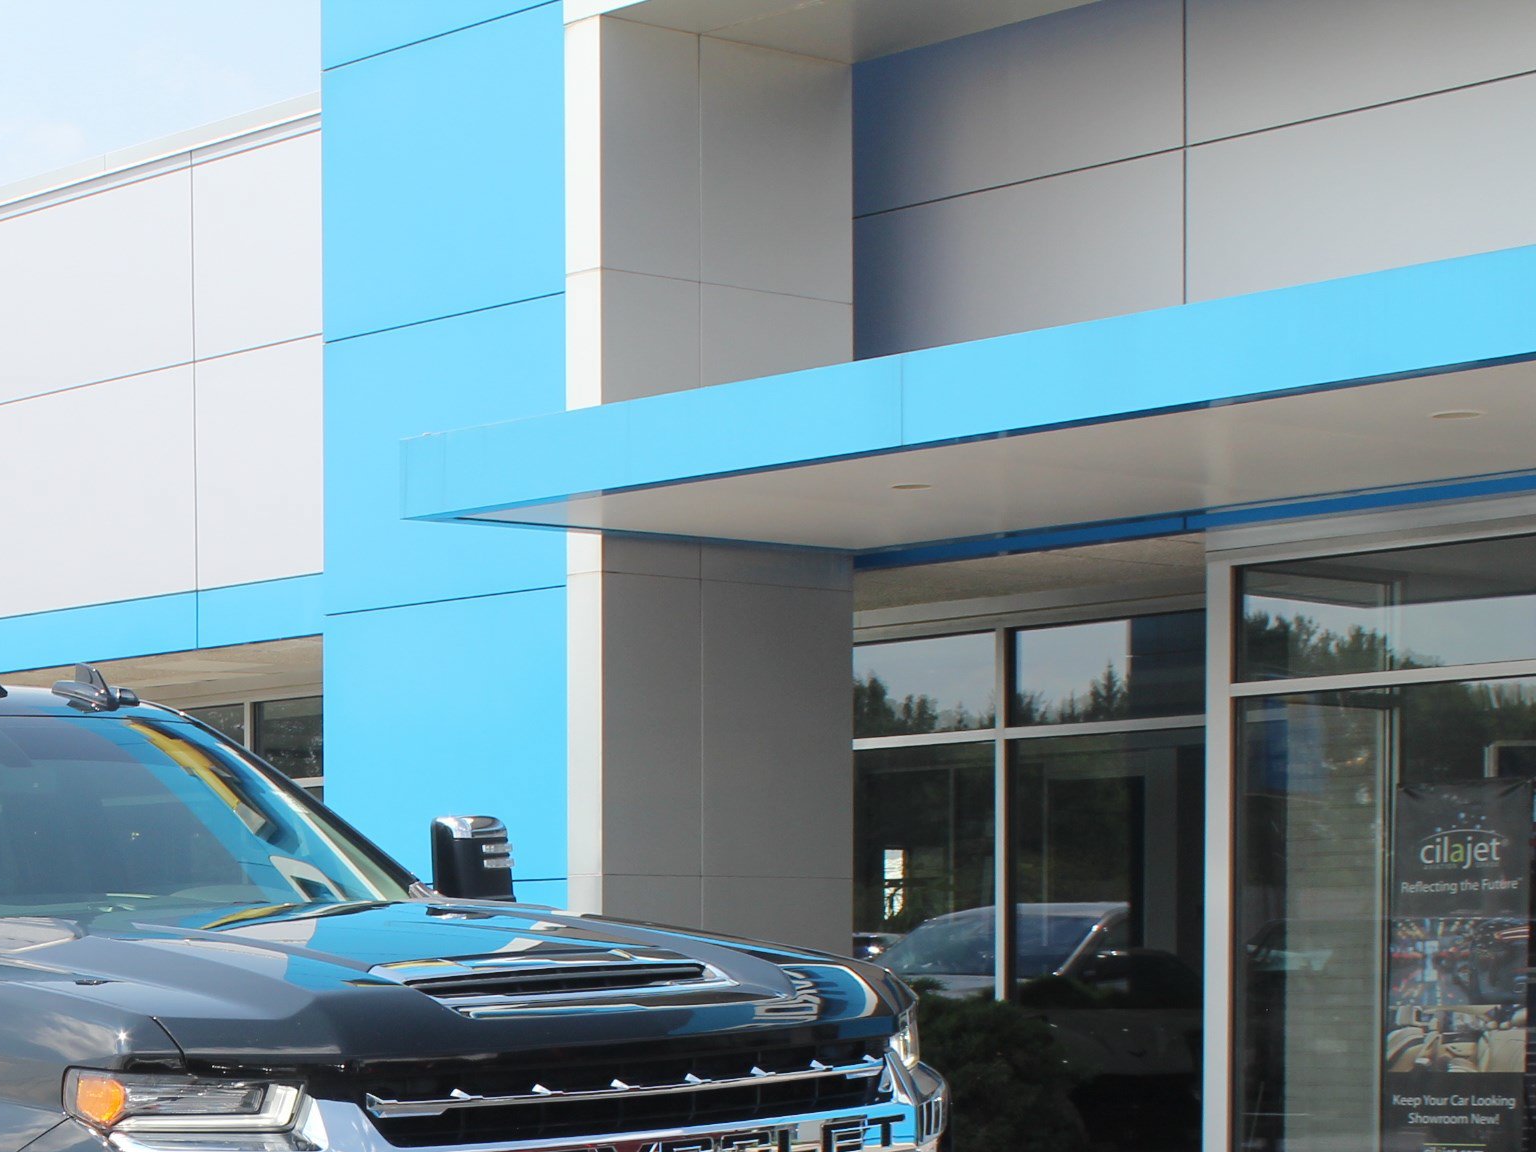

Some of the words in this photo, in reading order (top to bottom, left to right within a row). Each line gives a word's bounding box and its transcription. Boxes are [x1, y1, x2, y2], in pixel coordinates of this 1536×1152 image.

[1419, 836, 1502, 870] cilajet
[1400, 881, 1458, 895] Reflecting
[1459, 879, 1480, 892] the
[1391, 1095, 1422, 1109] Keep
[1423, 1095, 1448, 1106] Your
[1449, 1095, 1470, 1106] Car
[1471, 1095, 1517, 1110] Looking
[1407, 1112, 1469, 1125] Showroom
[1470, 1113, 1501, 1125] New!
